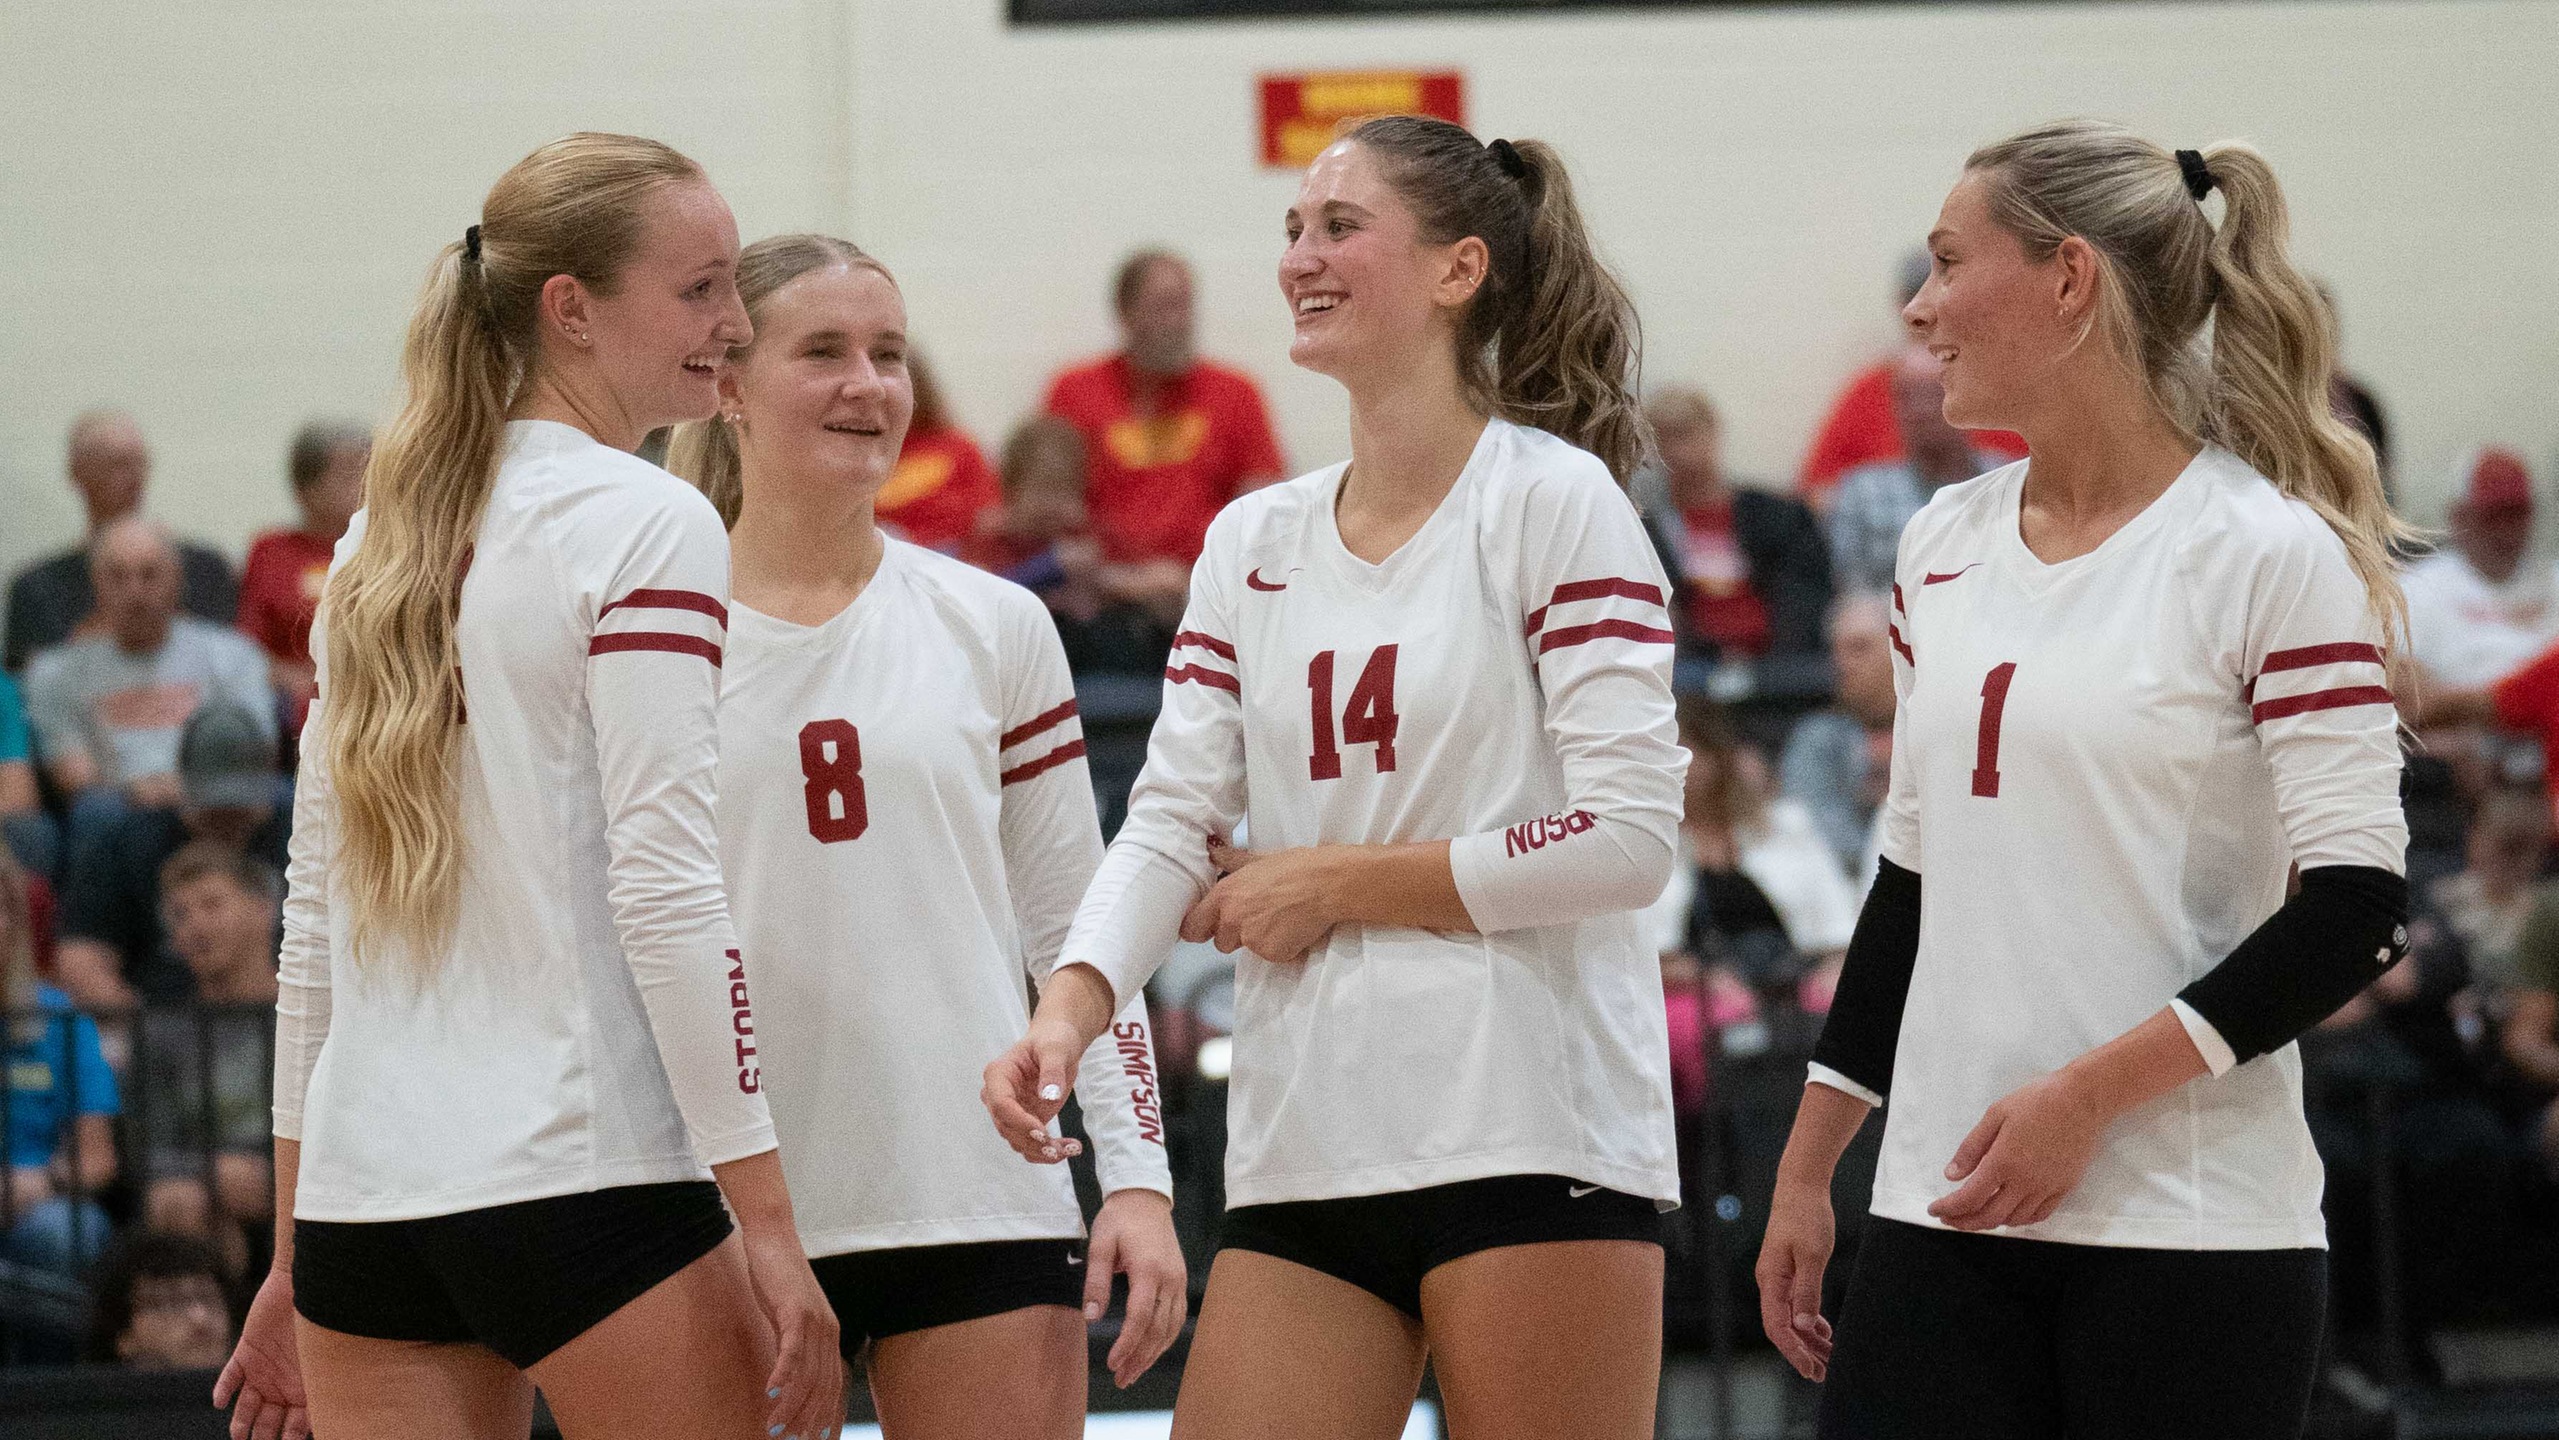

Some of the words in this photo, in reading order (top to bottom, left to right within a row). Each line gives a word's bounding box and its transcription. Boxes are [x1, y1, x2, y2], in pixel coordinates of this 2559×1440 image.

[1308, 643, 1399, 781] 14
[1971, 662, 2017, 798] 1
[798, 718, 869, 844] 8
[1112, 1021, 1164, 1147] SIMPSON
